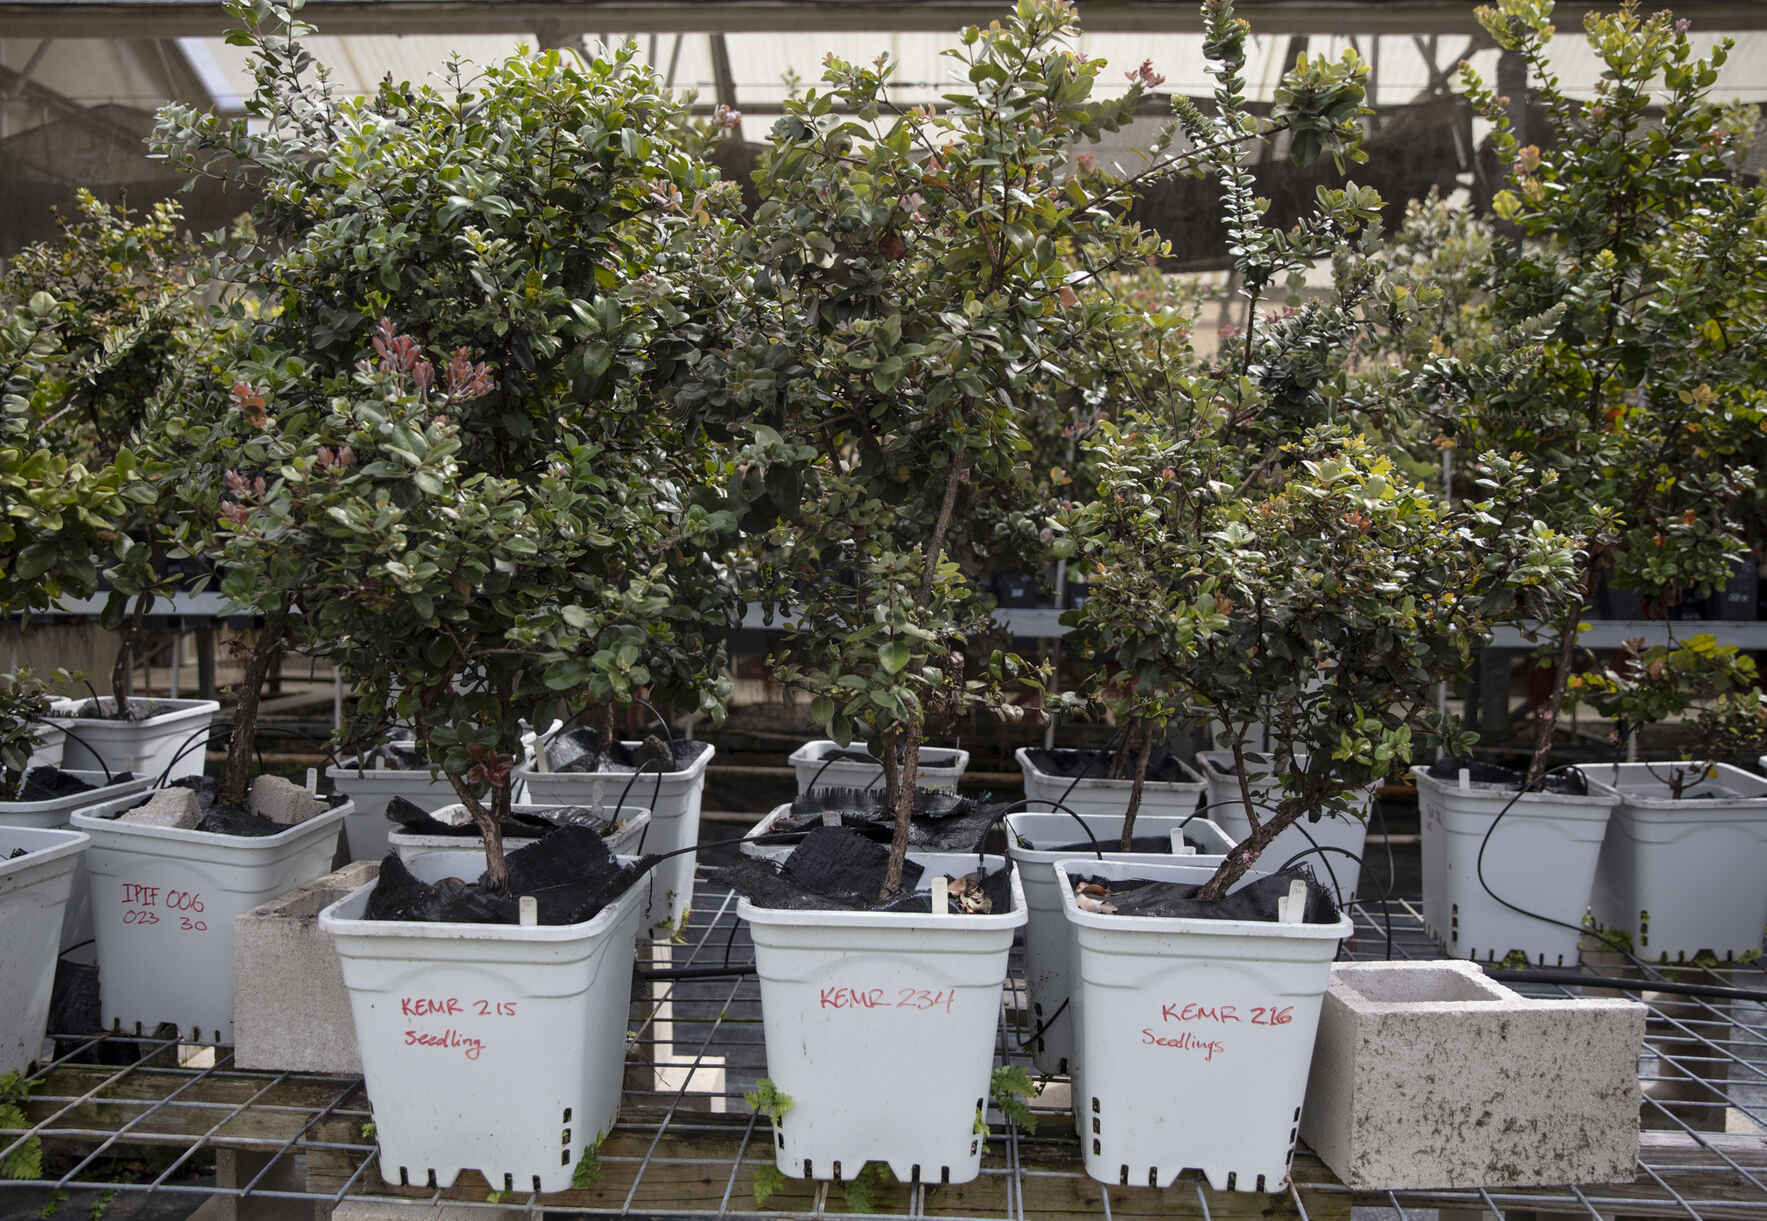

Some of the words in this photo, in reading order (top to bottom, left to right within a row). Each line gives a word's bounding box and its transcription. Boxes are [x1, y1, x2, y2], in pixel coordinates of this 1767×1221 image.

[121, 883, 160, 906] IPIF
[166, 889, 205, 912] 006
[123, 909, 160, 925] 023
[179, 916, 208, 931] 30
[401, 997, 464, 1016] KEMR
[472, 999, 517, 1016] 215
[820, 986, 892, 1009] KEMR
[896, 988, 955, 1014] 234
[1161, 1003, 1240, 1023] KEMR
[1250, 1006, 1294, 1025] 216
[404, 1028, 487, 1061] Seedling
[1142, 1028, 1225, 1062] Seedlings
